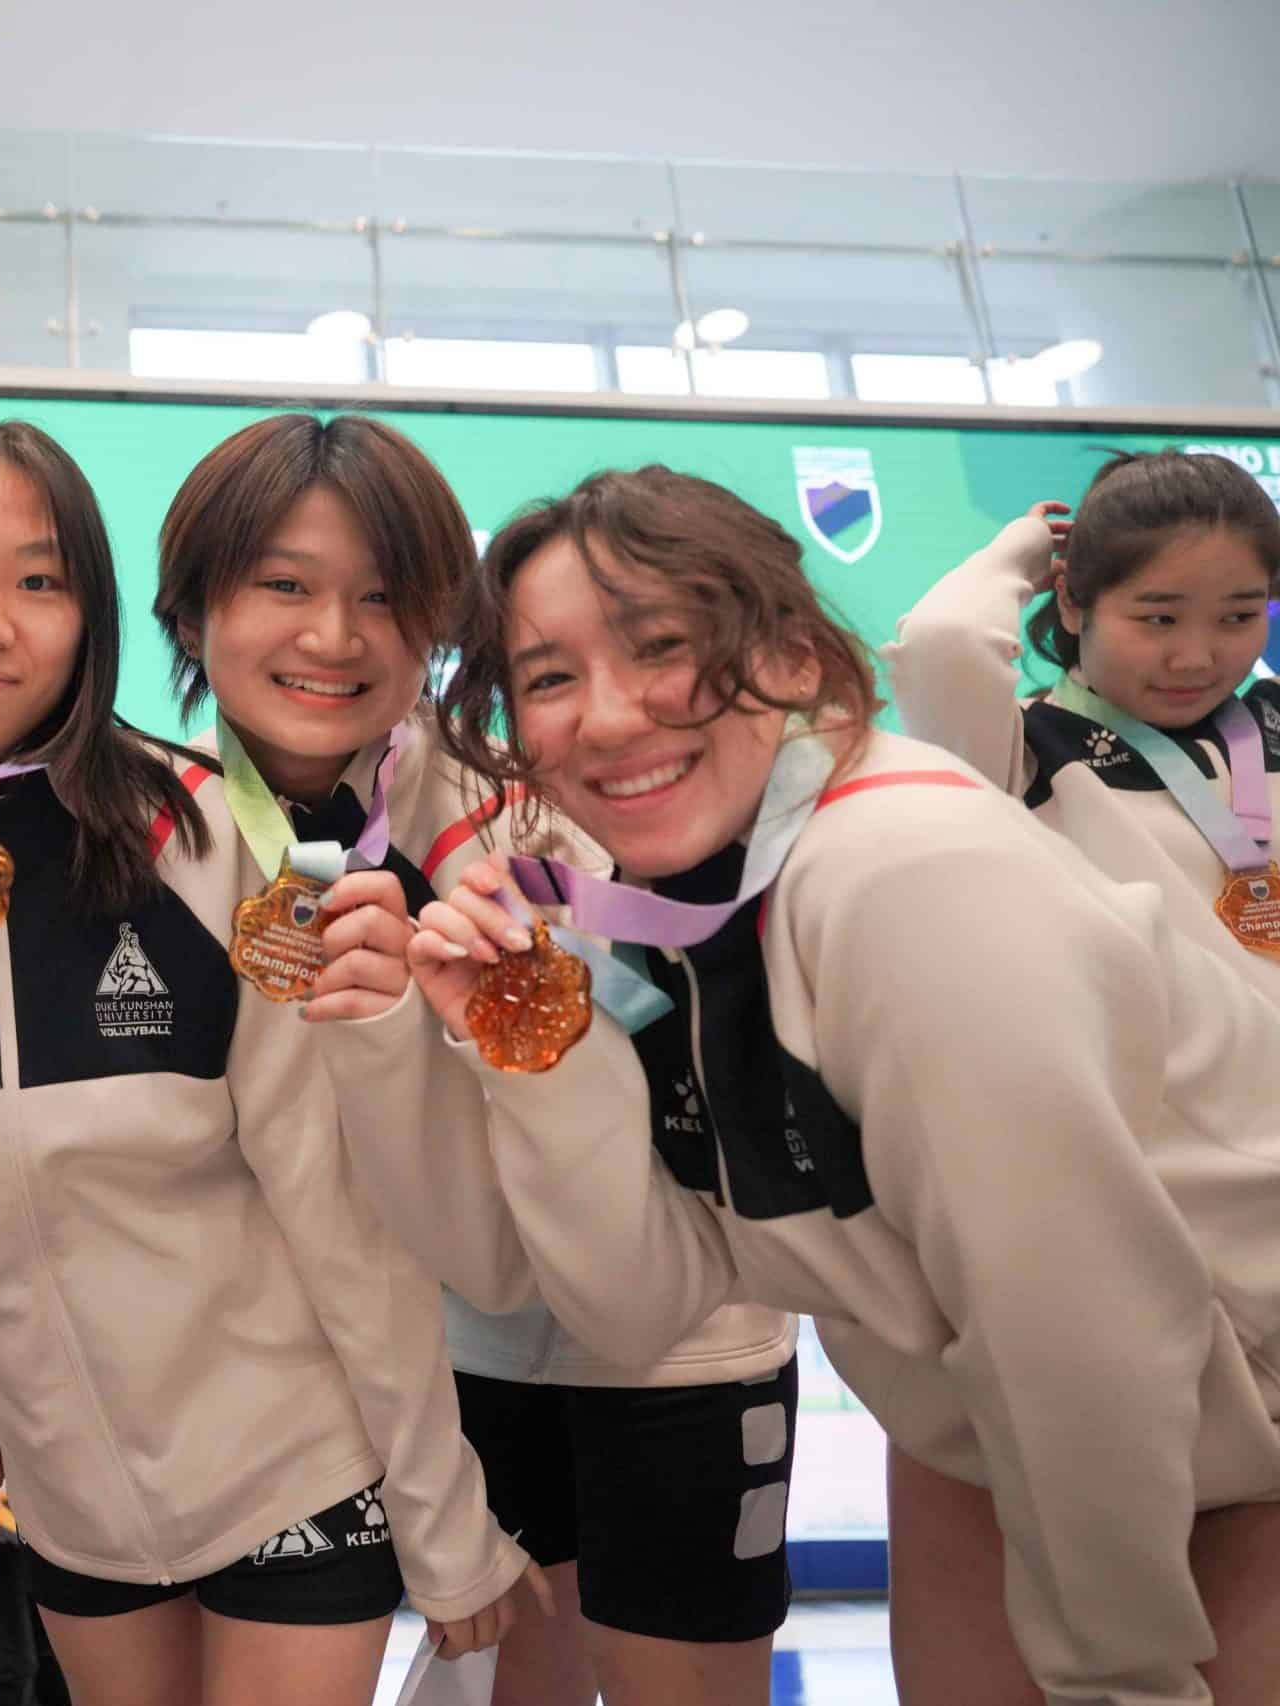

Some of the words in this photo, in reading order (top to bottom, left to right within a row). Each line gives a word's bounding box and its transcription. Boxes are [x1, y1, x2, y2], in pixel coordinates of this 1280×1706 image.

[240, 947, 321, 980] Champion
[96, 1001, 118, 1012] DUKE
[120, 1000, 174, 1010] KUNSHAN
[96, 1010, 174, 1022] UNIVERSITY
[99, 1025, 172, 1037] VOLLEYBALL
[345, 1528, 391, 1547] KELM
